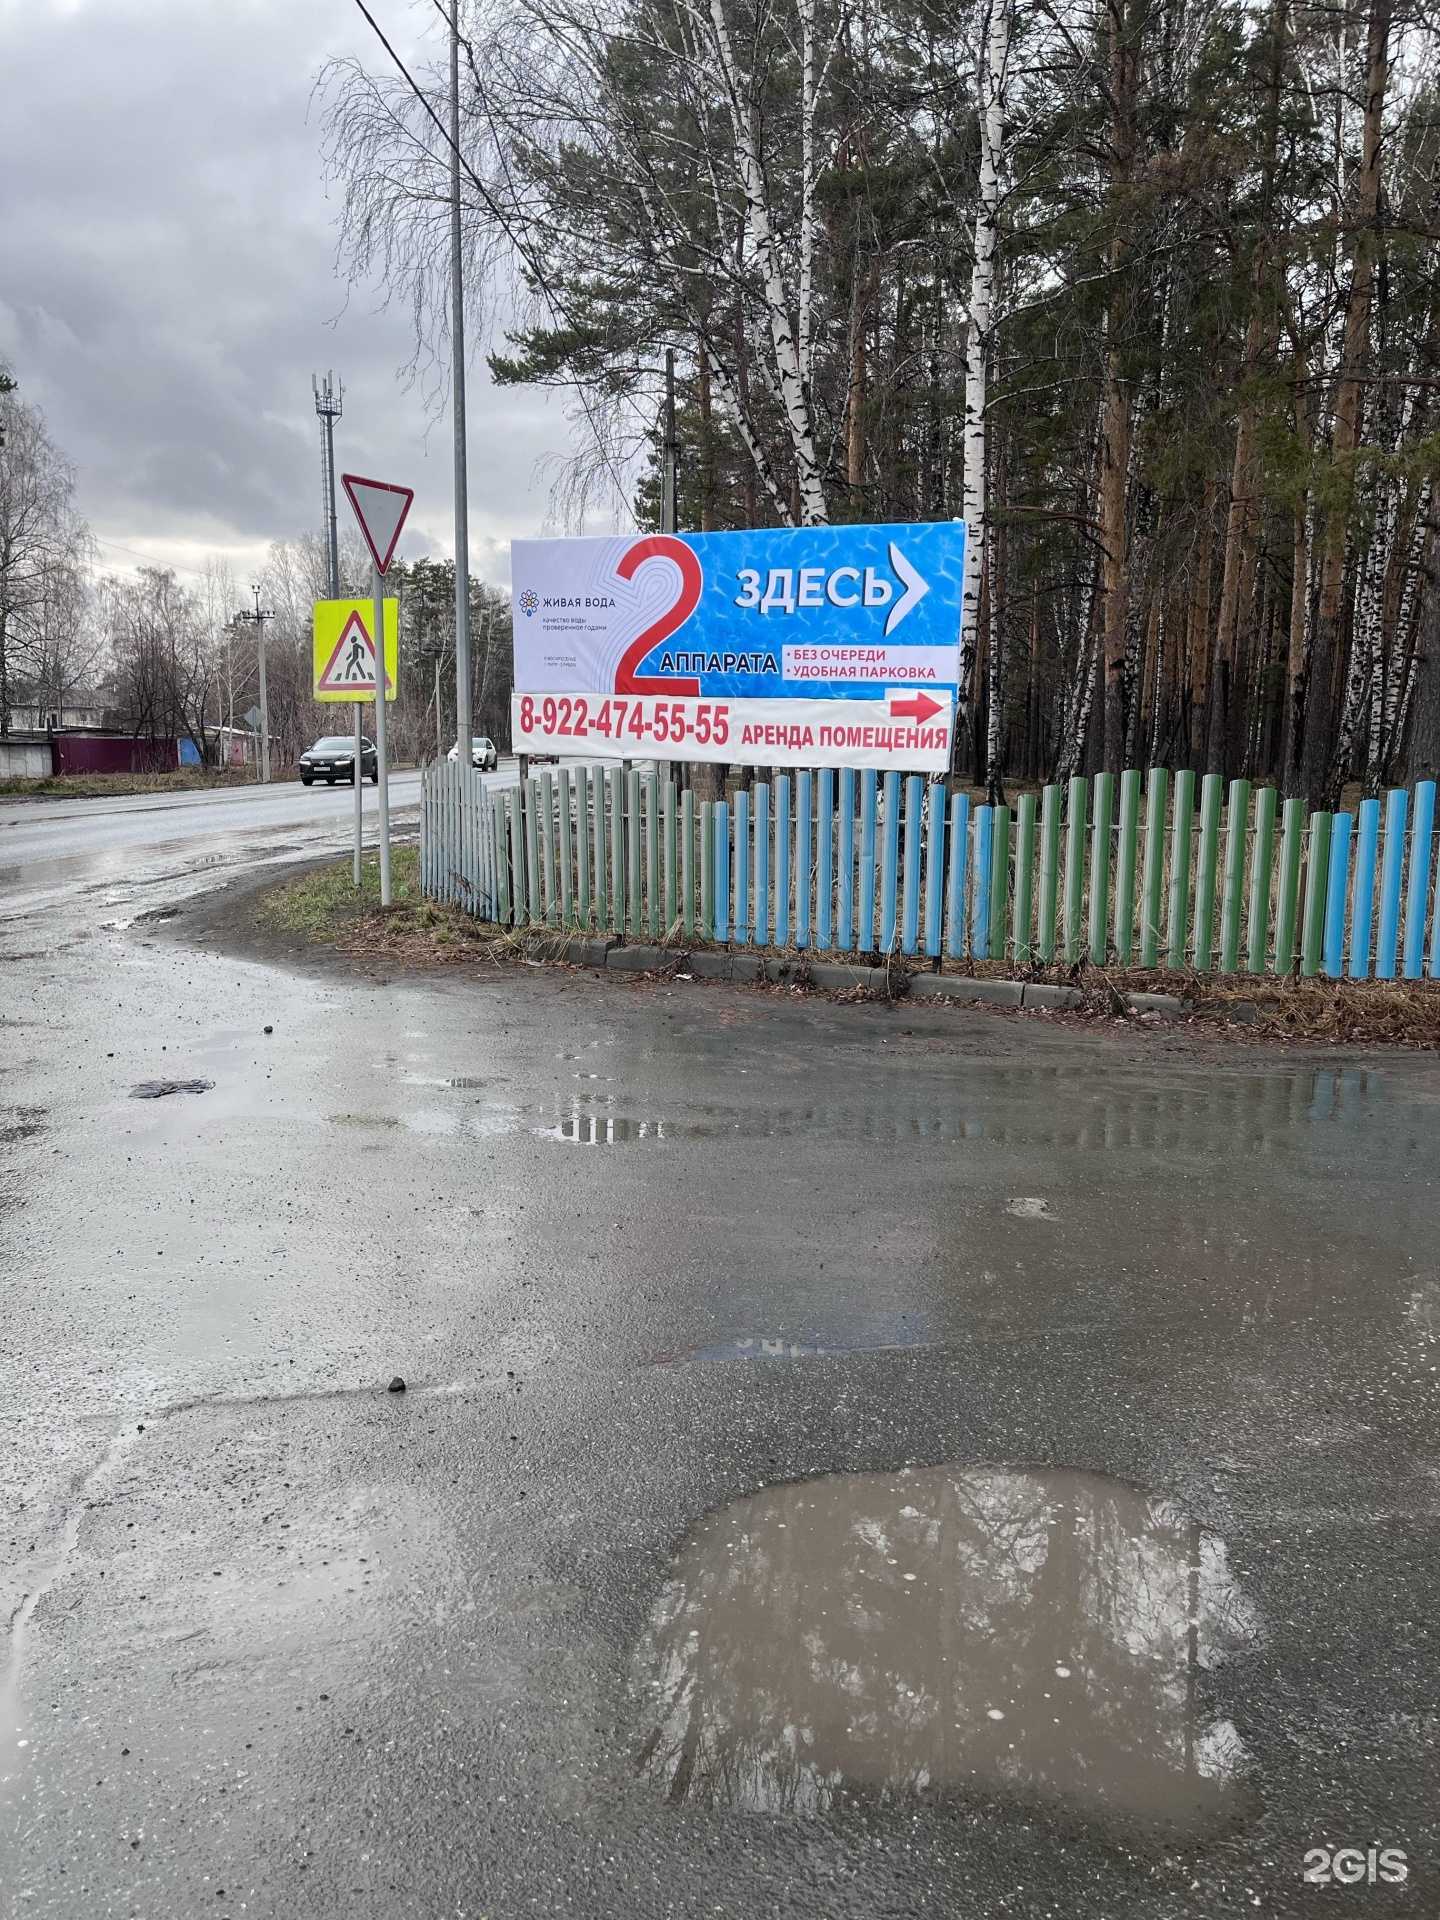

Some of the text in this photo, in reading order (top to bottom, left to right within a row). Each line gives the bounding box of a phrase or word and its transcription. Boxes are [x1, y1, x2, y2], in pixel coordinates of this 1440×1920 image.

[734, 566, 893, 615] ЗДЕСЬ
[543, 597, 616, 609] ЖИВАЯ ВОДА
[571, 617, 587, 625] воды
[615, 536, 704, 698] 2
[659, 651, 779, 675] АППАРАТА
[793, 649, 886, 662] БЕЗ ОЧЕРЕДИ
[793, 666, 936, 679] УДОБНАЯ ПАРКОВКА
[520, 696, 729, 745] 8-922-474-55-55
[742, 724, 948, 752] АРЕНДА ПОМЕЩЕНИЯ
